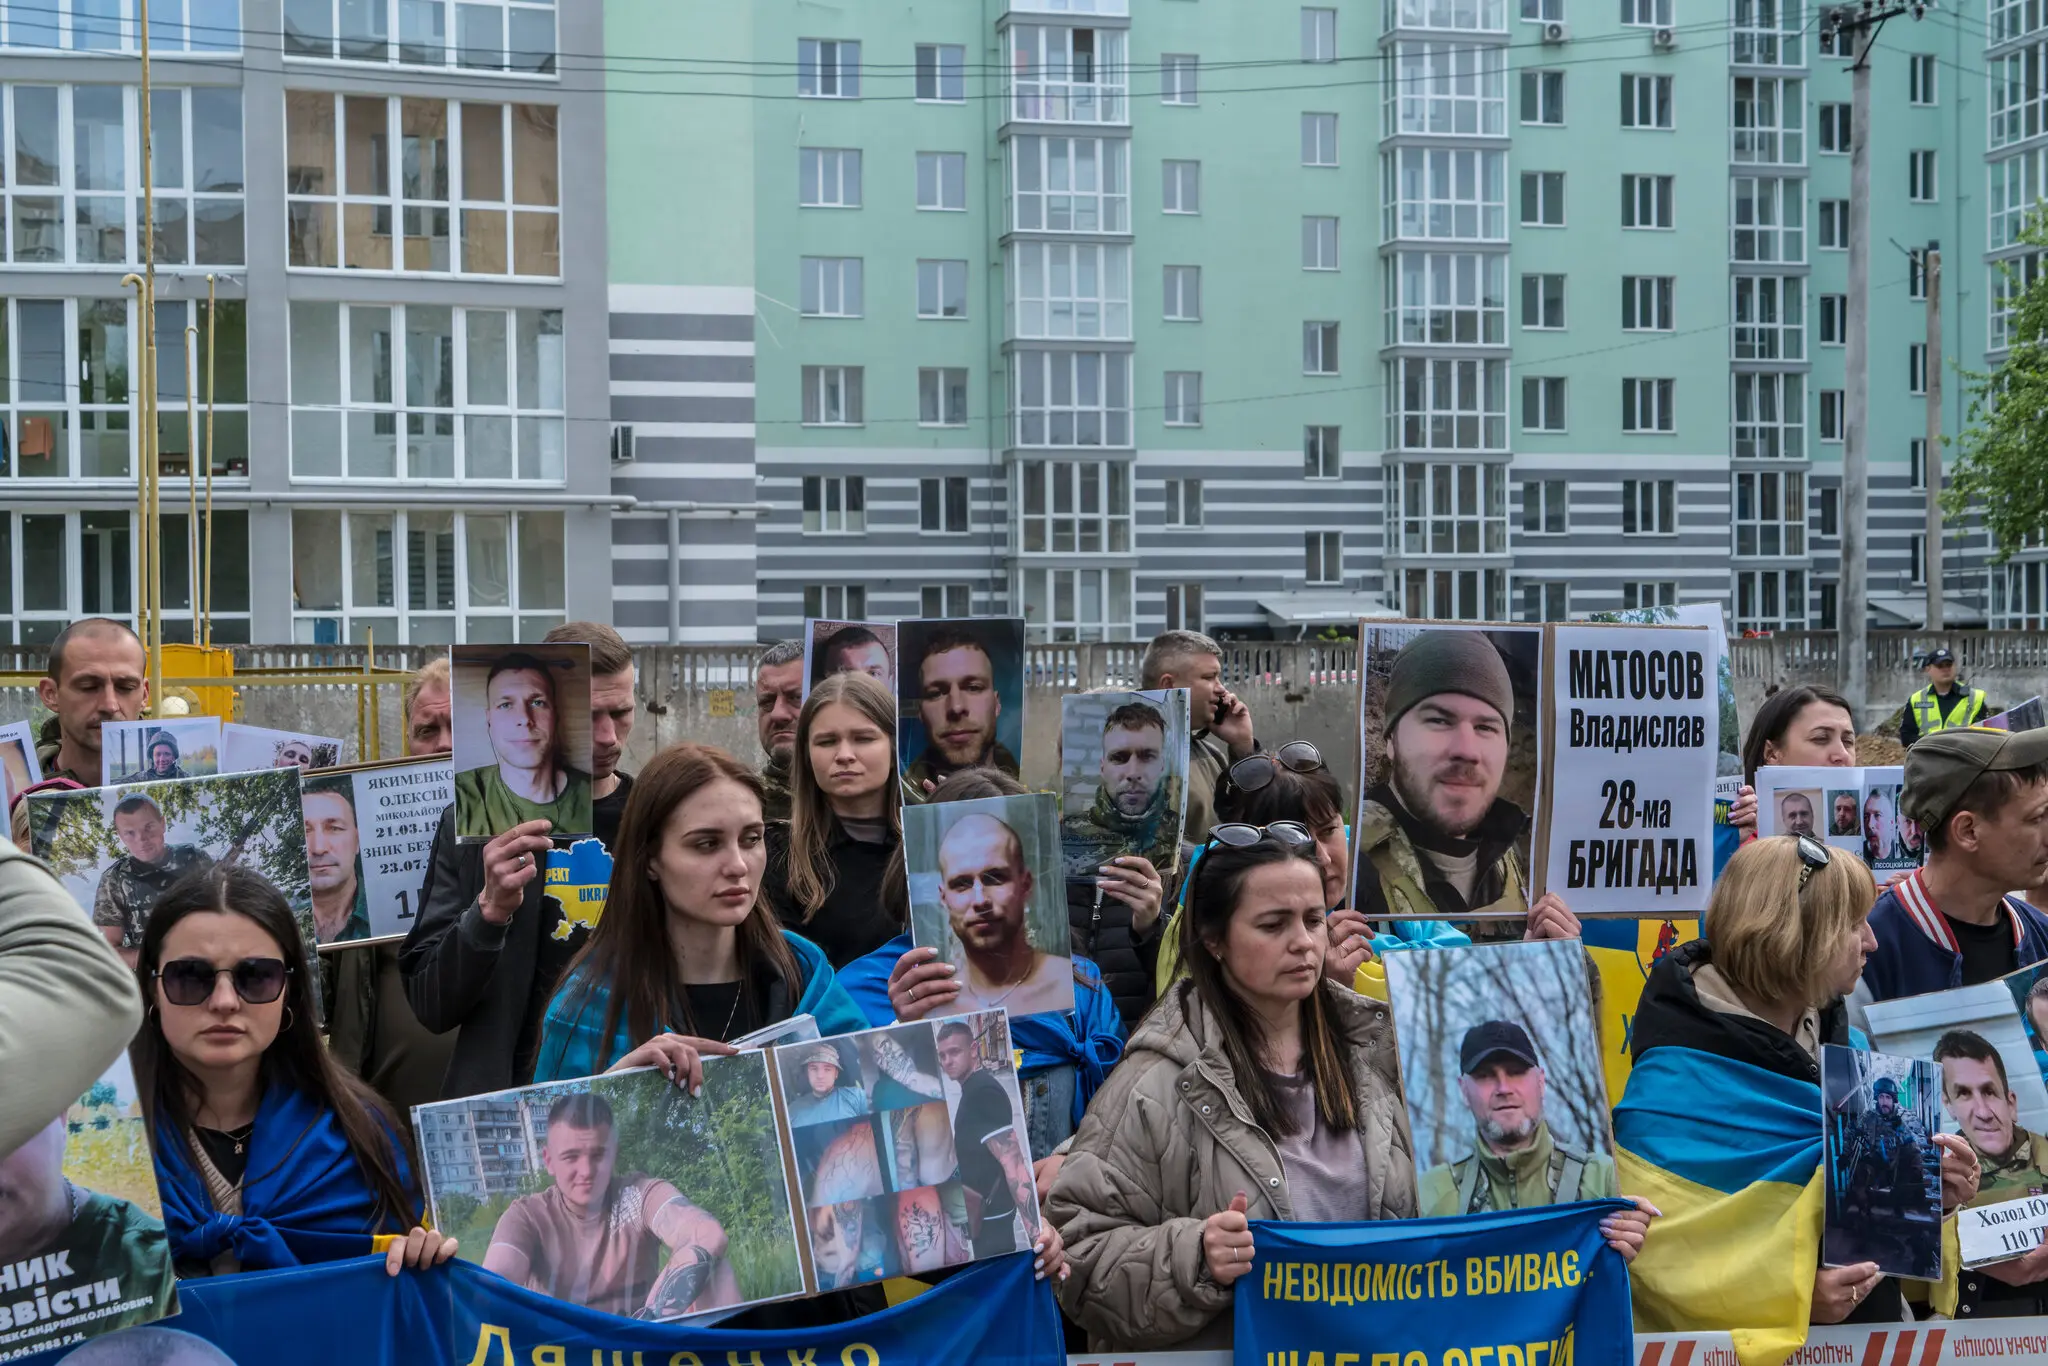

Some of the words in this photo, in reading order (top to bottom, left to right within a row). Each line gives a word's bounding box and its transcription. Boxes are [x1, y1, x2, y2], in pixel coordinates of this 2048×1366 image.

[1569, 649, 1704, 700] МАТОСОВ
[1570, 708, 1705, 753] Владислав
[368, 769, 454, 790] ЯКИМЕНКО
[379, 787, 449, 807] ОЛЕКСІЙ
[1599, 779, 1671, 829] 28-ма
[376, 806, 445, 822] МИКОЛАЙОВ
[363, 843, 403, 859] ЗНИК
[407, 841, 433, 853] БЕЗ
[379, 859, 431, 875] 23.07.
[1567, 838, 1698, 895] БРИГАДА
[394, 888, 425, 919] 1
[1976, 1207, 2027, 1228] Холод
[2027, 1198, 2048, 1217] Ю
[2001, 1230, 2029, 1251] 110
[2030, 1225, 2048, 1245] Т
[1263, 1260, 1458, 1306] НЕВІДОМІСТЬ
[1953, 1335, 2004, 1358] ПОЛІЦІЯ
[2005, 1335, 2048, 1355] АЛЬНА
